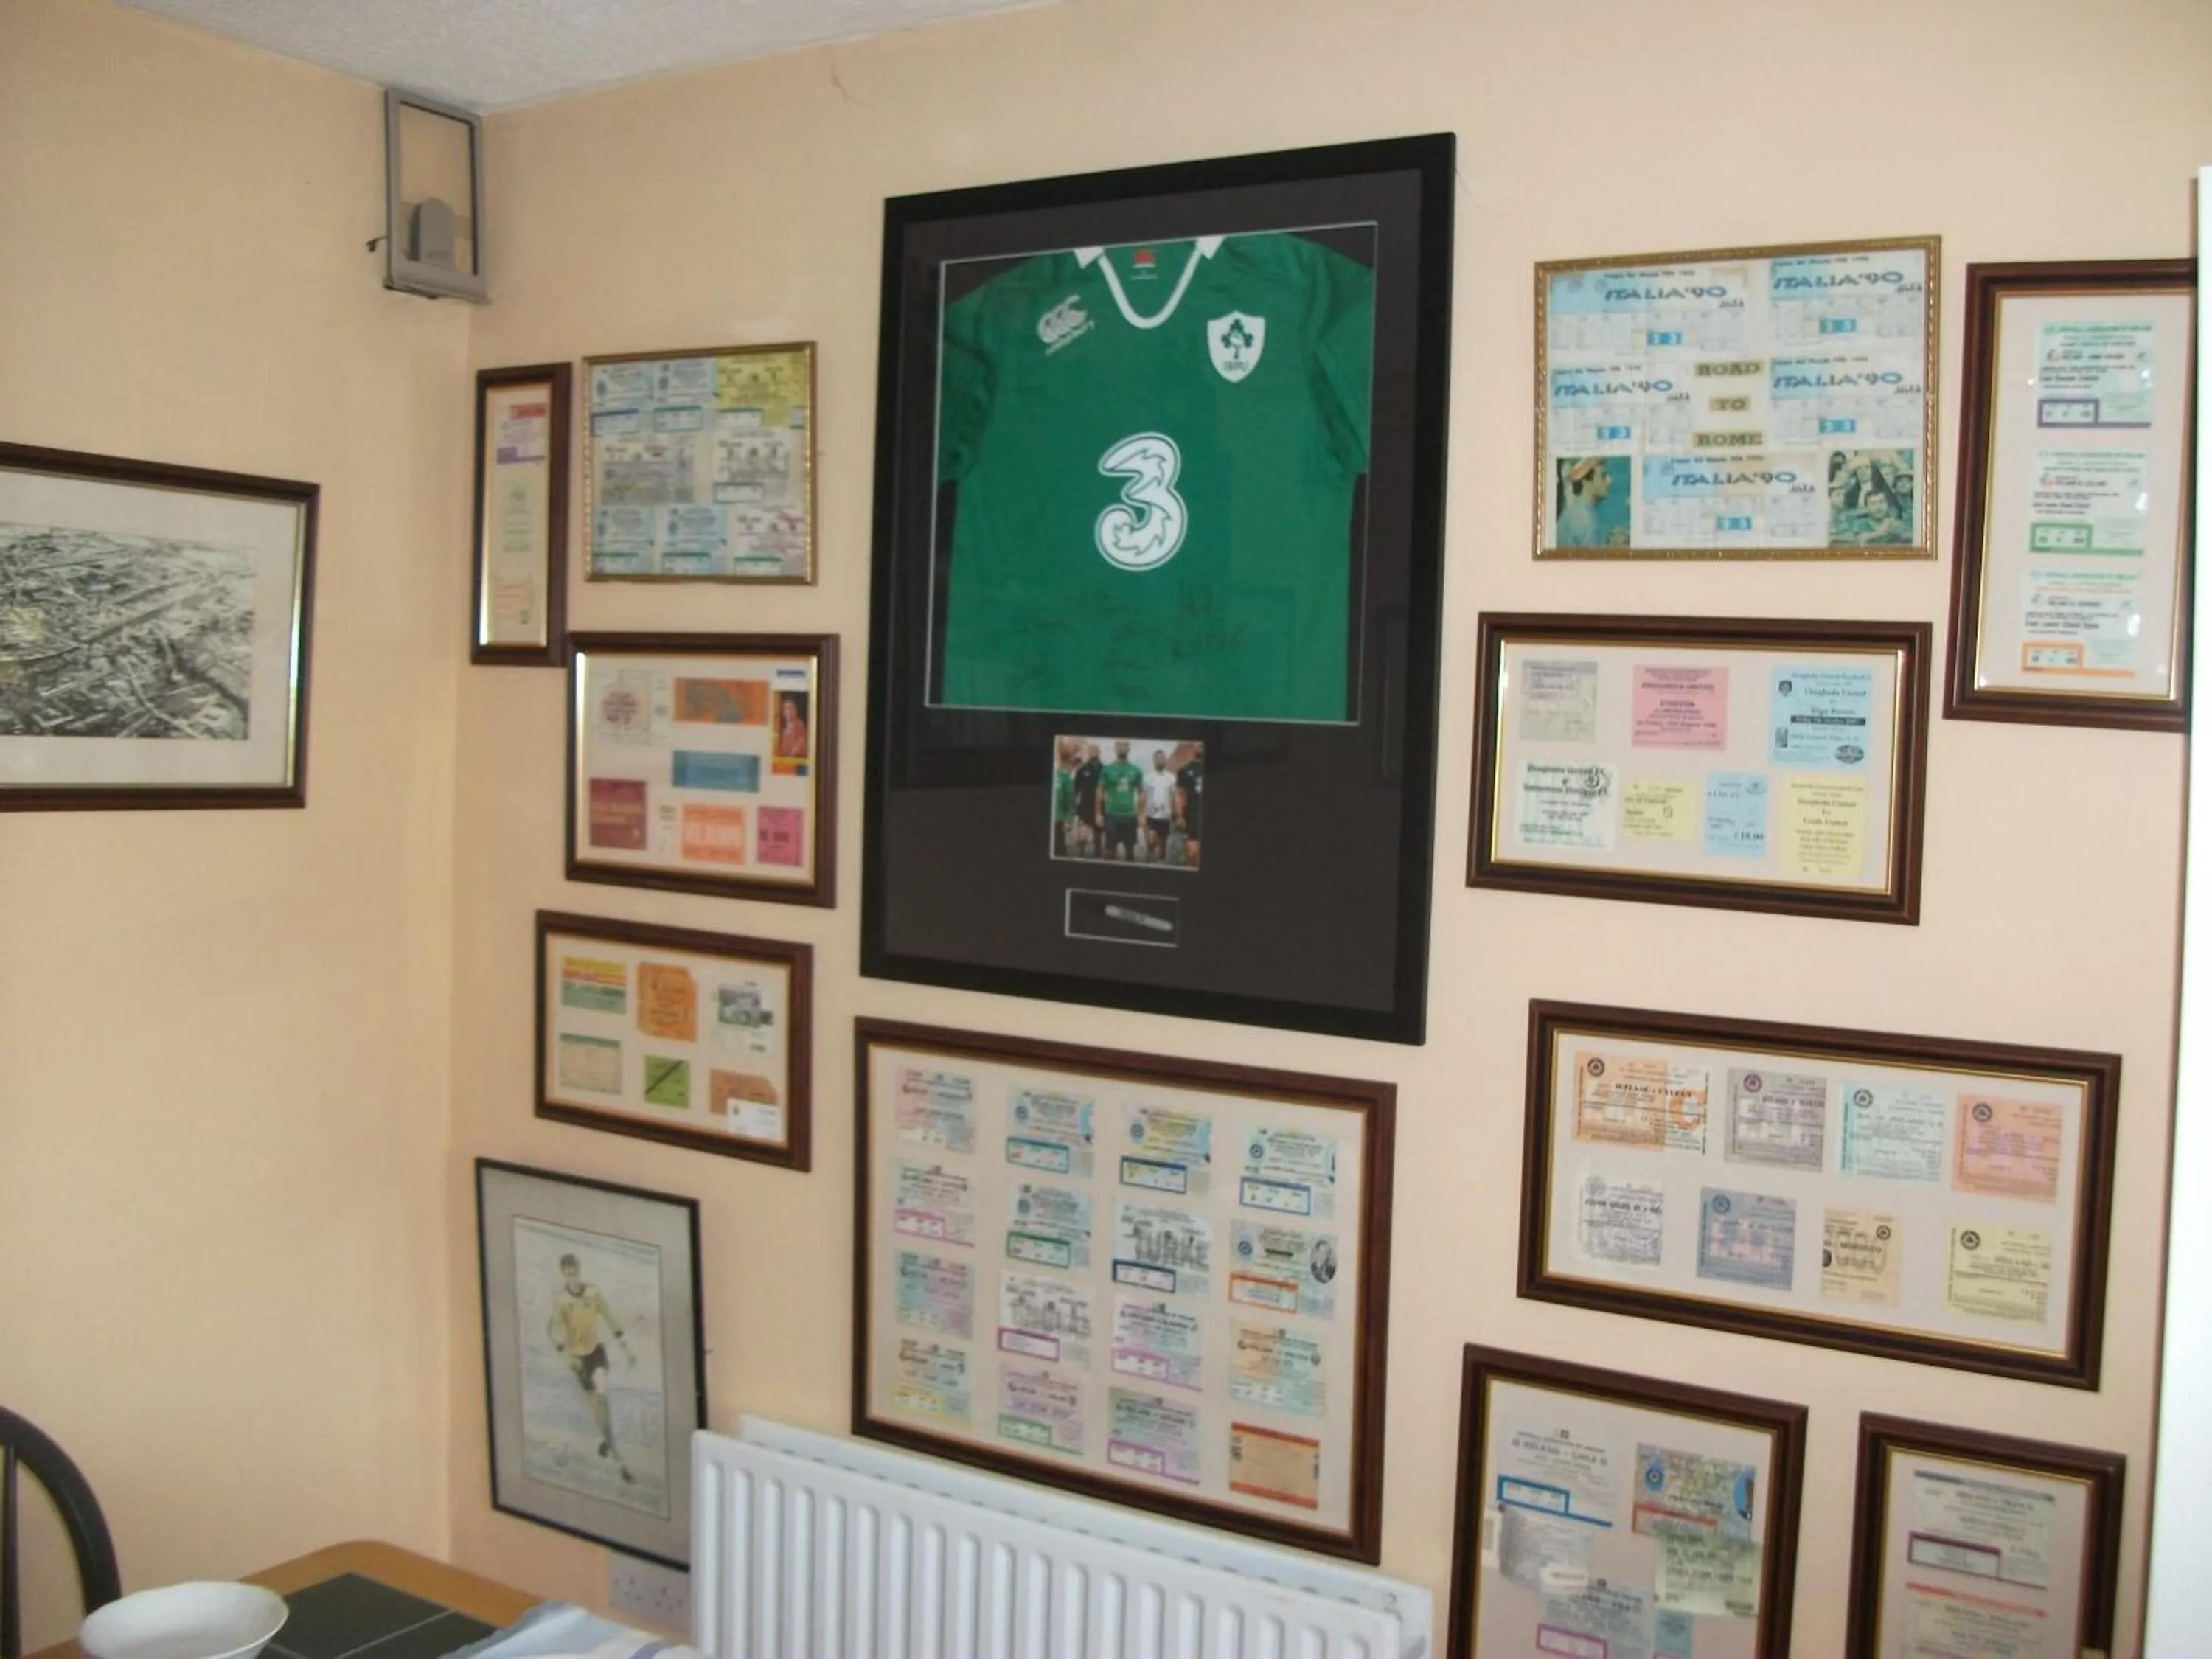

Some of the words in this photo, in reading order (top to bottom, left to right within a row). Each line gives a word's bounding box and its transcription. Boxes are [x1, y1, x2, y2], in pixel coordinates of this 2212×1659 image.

[1697, 362, 1761, 376] ROAD
[1716, 397, 1746, 411] TO
[1697, 433, 1762, 447] ROME
[1095, 431, 1189, 571] 3
